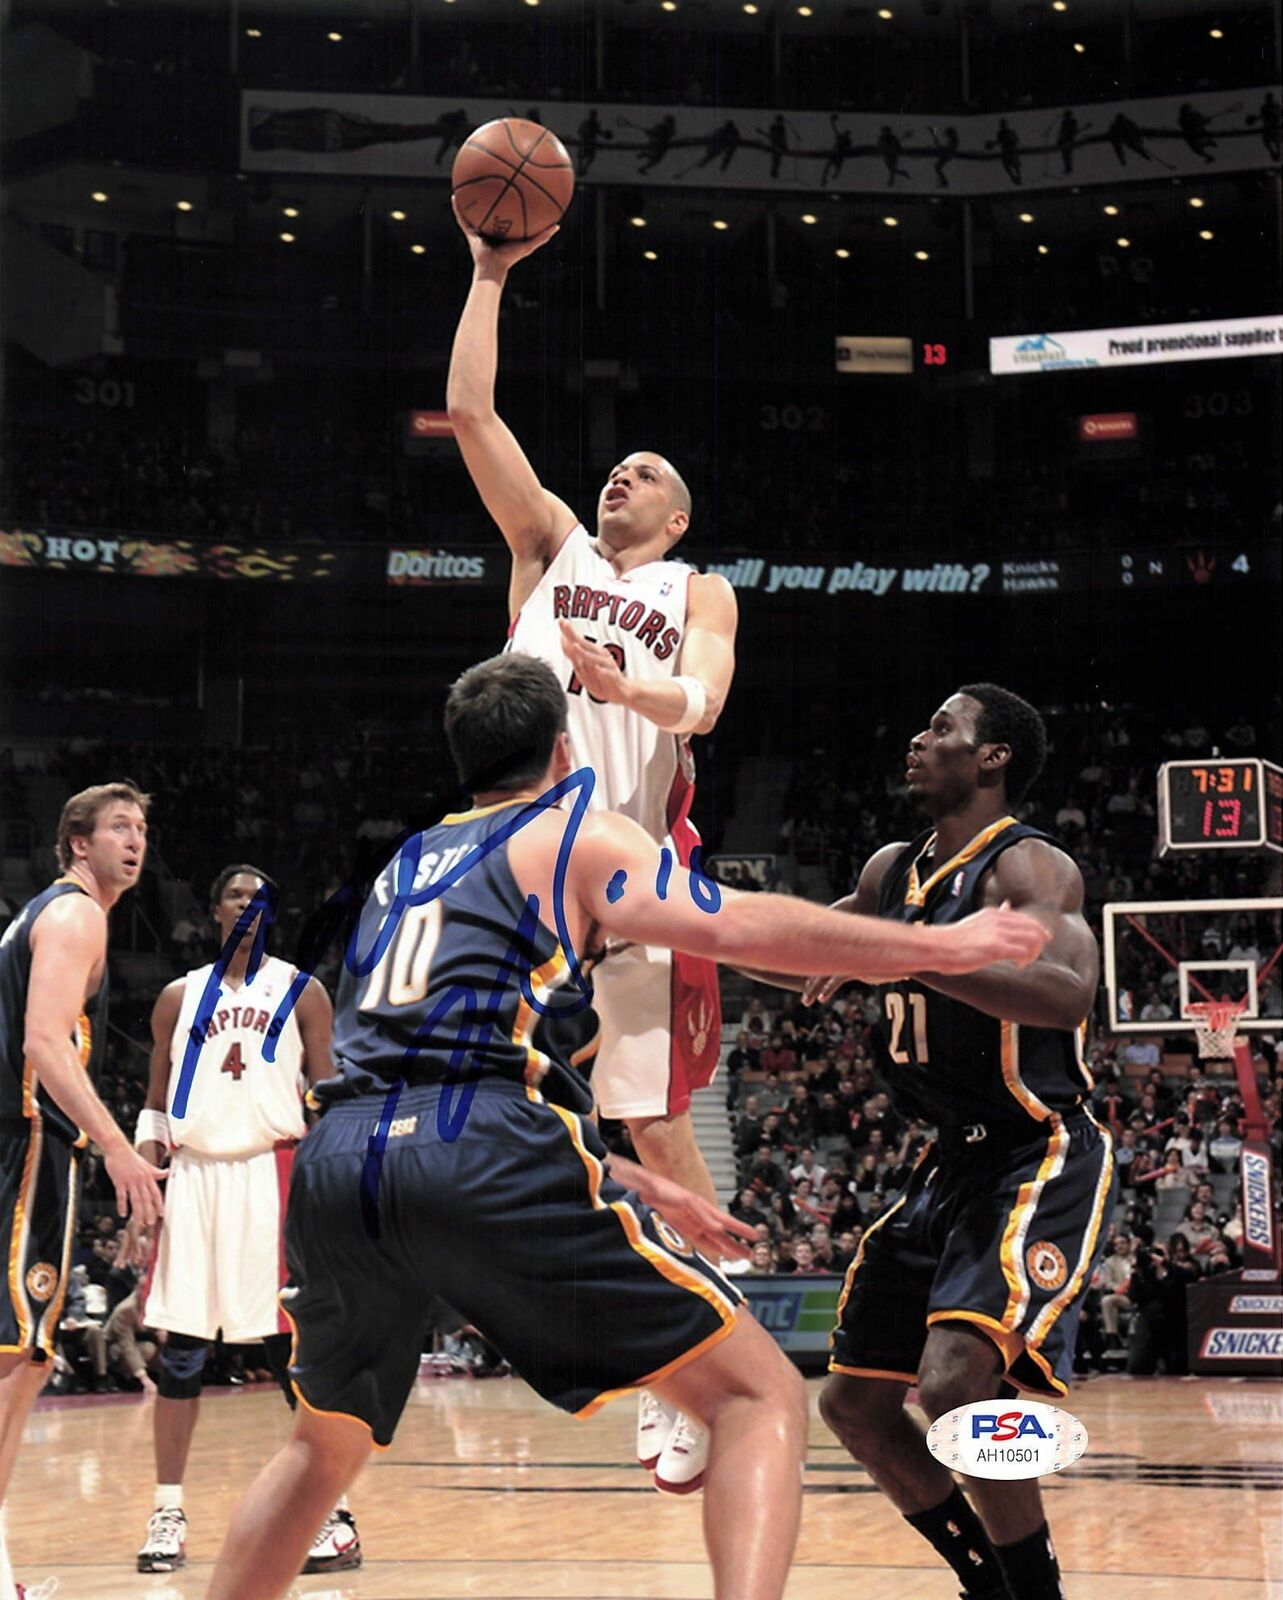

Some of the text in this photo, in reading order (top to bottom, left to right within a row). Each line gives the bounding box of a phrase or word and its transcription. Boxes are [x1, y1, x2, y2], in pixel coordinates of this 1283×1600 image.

[923, 343, 947, 365] 13
[1108, 337, 1144, 355] Proud
[1147, 331, 1222, 354] promotional
[1224, 328, 1276, 348] supplier
[74, 377, 136, 408] 301
[1184, 391, 1252, 419] 303
[760, 405, 824, 430] 302
[45, 535, 120, 564] HOT
[387, 550, 485, 578] Doritos
[1002, 561, 1060, 576] Knicks
[1231, 554, 1249, 574] 4
[765, 563, 824, 593] you
[827, 561, 897, 596] play
[902, 562, 990, 593] with?
[1002, 577, 1059, 591] Hawks
[553, 585, 680, 661] RAPTORS
[1191, 767, 1252, 793] 7:31
[1202, 799, 1241, 837] 13
[358, 897, 444, 1011] 10
[884, 991, 929, 1064] 21
[220, 1041, 247, 1081] 4
[1246, 1154, 1270, 1247] SNICKERS
